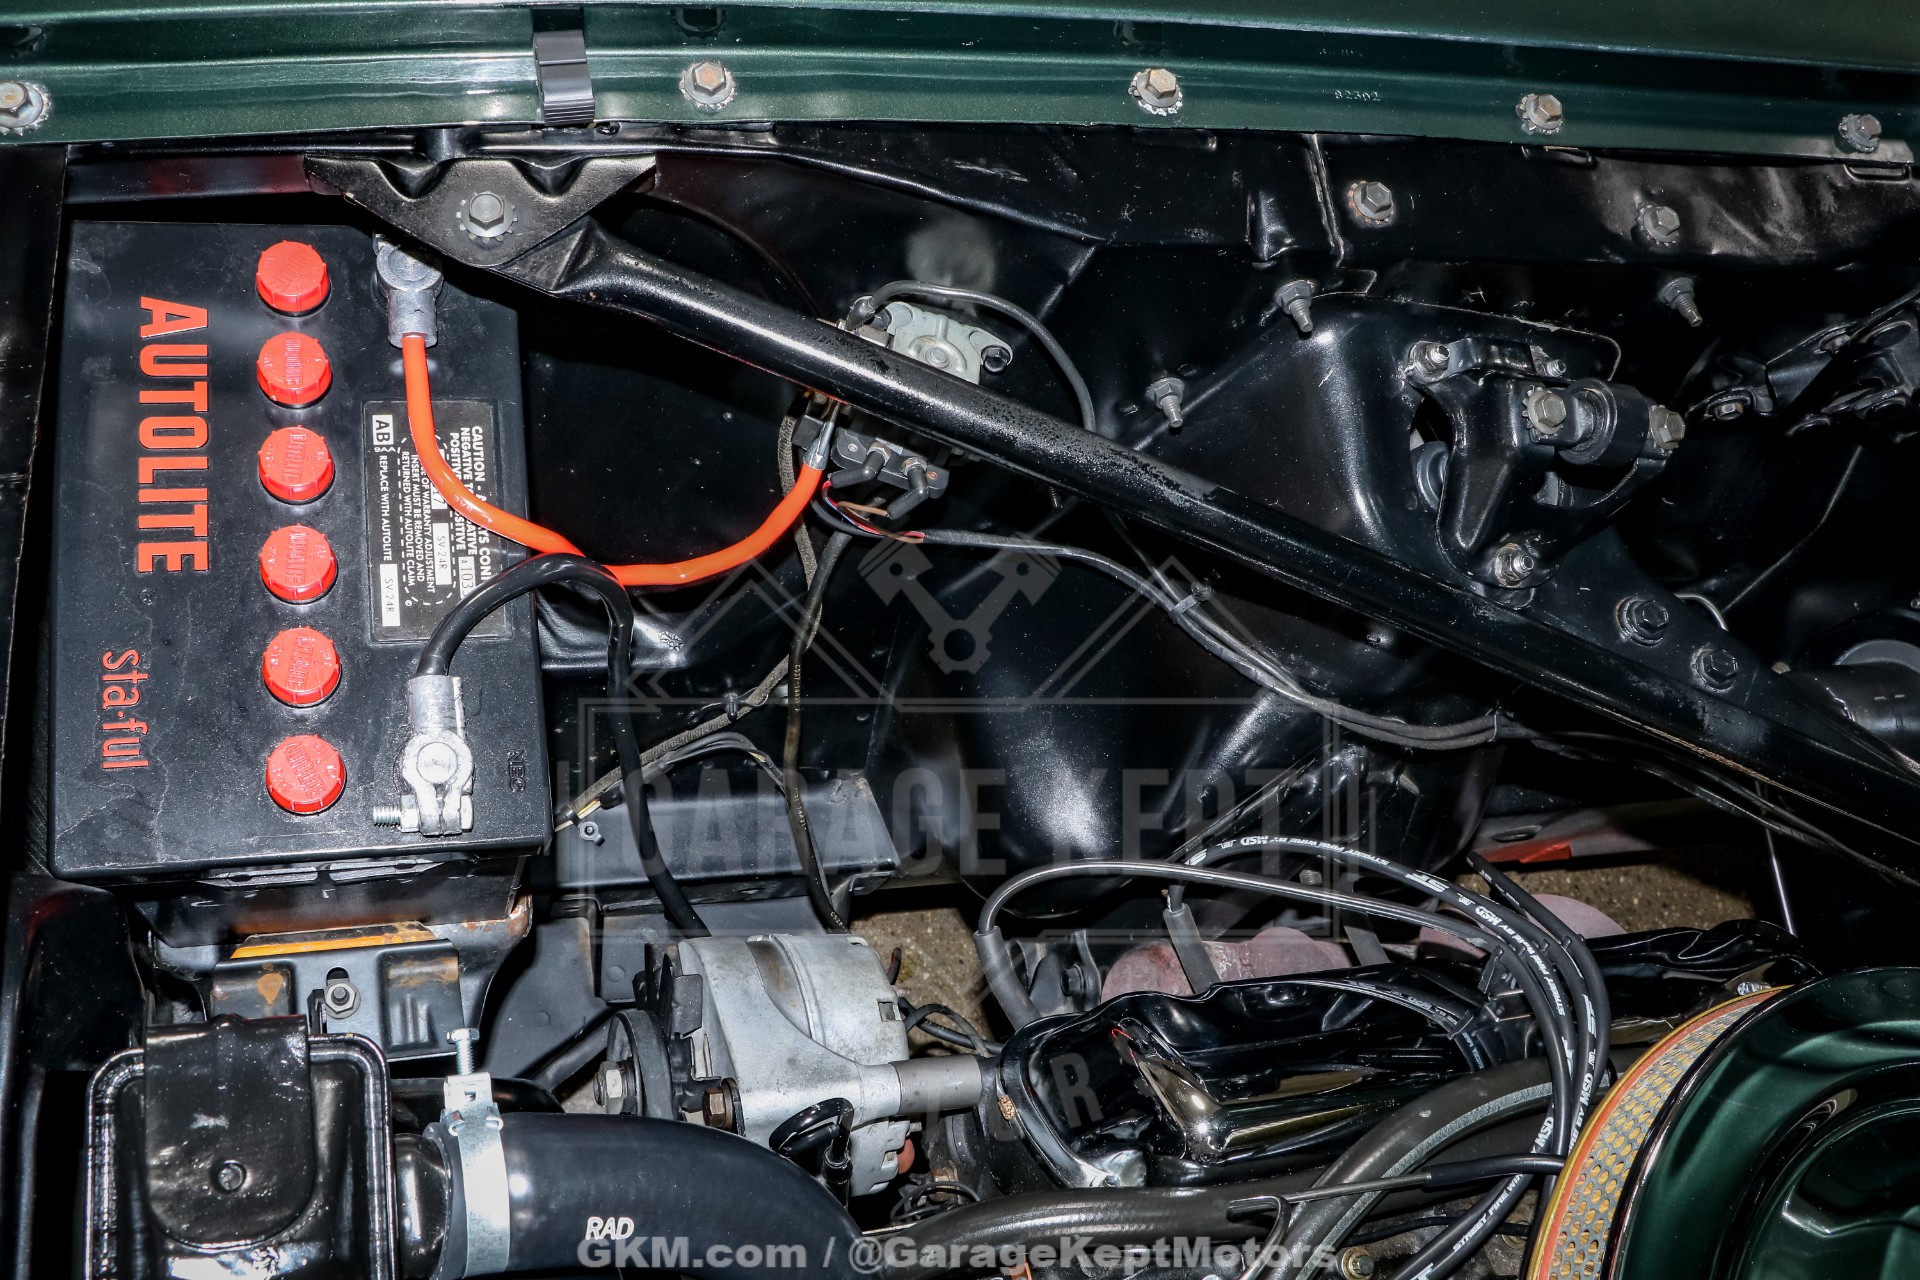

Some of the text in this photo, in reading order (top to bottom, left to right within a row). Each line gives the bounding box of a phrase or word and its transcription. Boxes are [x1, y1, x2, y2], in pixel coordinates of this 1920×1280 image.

[138, 295, 209, 573] AUTOLITE
[376, 419, 391, 443] AB
[461, 427, 473, 480] NEGATIVE
[471, 426, 485, 482] CAUTION
[421, 478, 430, 490] OF
[379, 455, 395, 613] REPLACE WITH AUTOLITE SV-24R
[401, 451, 416, 587] RETURNED WITH AUTOLITE CLAIM
[411, 454, 426, 582] INSERT MUST BE REMOVED AND
[422, 490, 432, 536] WARRANTY
[424, 537, 436, 593] ADJUSTMENT
[436, 535, 448, 570] SV-24R
[1240, 835, 1269, 847] MSD
[1474, 905, 1502, 926] MSD
[1579, 1072, 1594, 1106] MSD
[1452, 1212, 1487, 1252] STREET
[1488, 1196, 1509, 1216] FIRE
[1534, 1116, 1555, 1149] MSD
[585, 1216, 635, 1240] RAD
